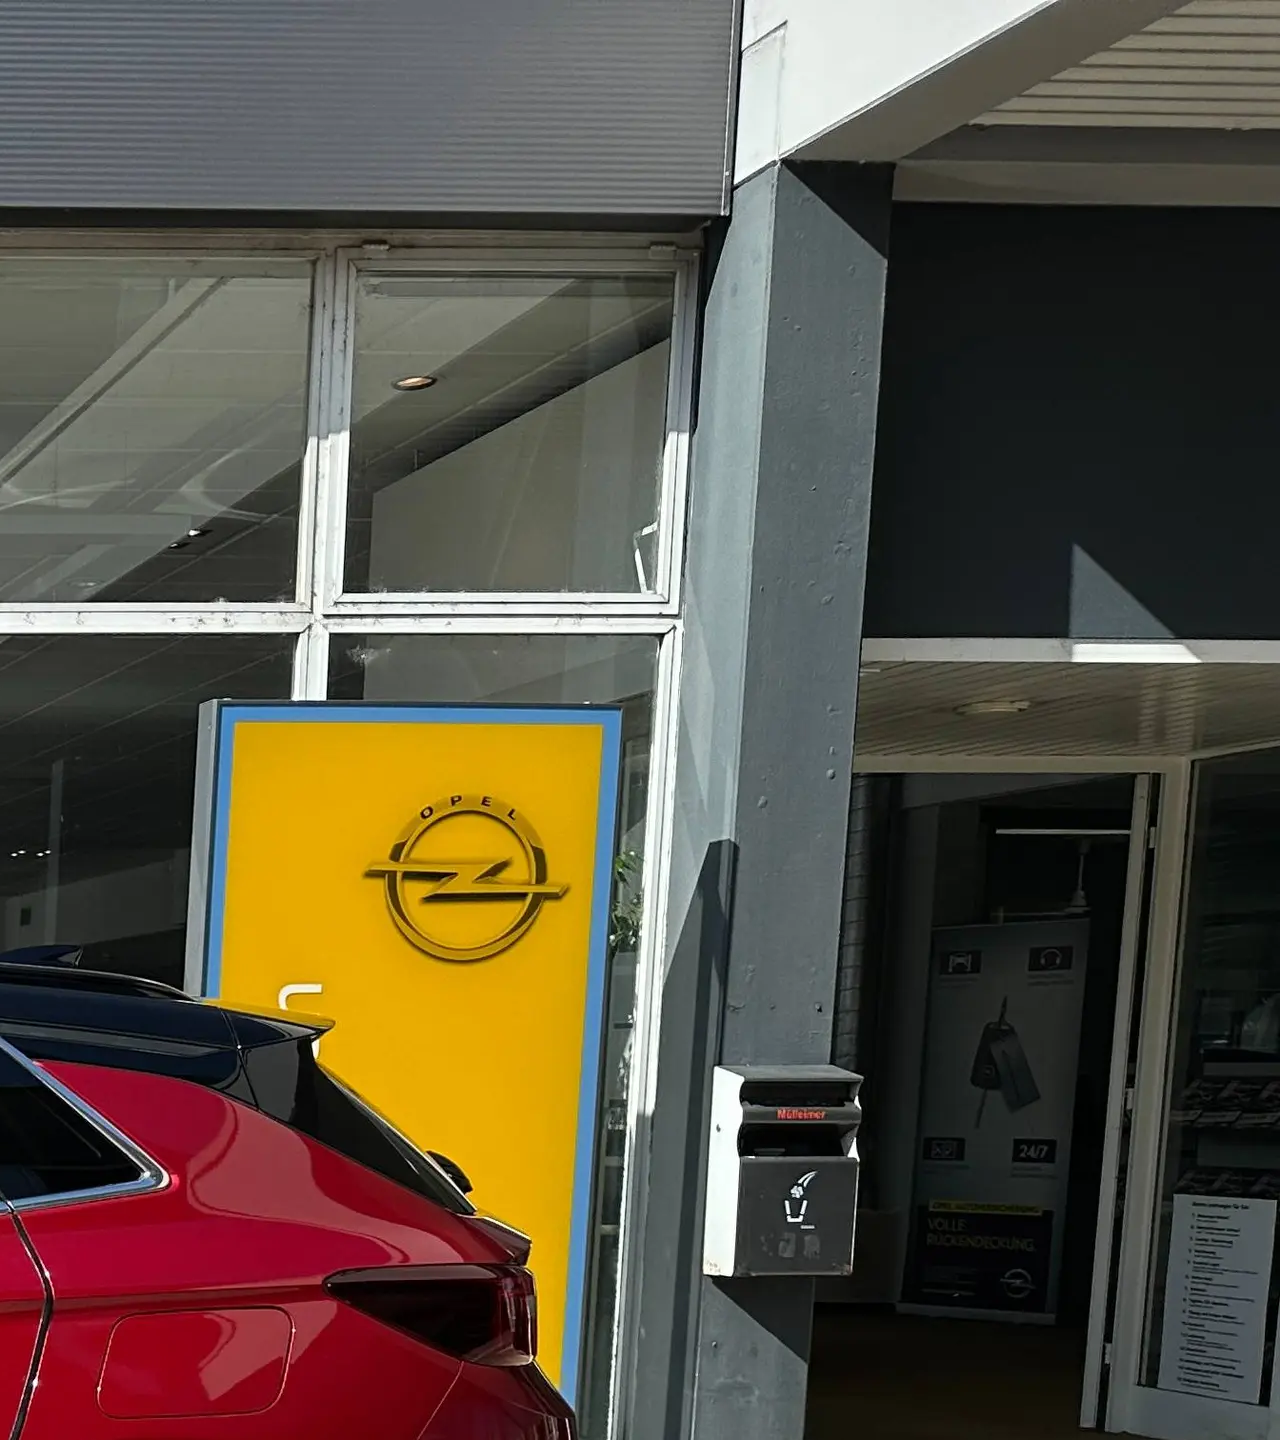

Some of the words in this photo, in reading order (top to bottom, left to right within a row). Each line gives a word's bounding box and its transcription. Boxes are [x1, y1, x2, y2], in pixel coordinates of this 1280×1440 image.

[420, 795, 516, 820] OPEL
[1019, 1144, 1048, 1158] 24/7
[928, 1218, 967, 1232] VOLLE
